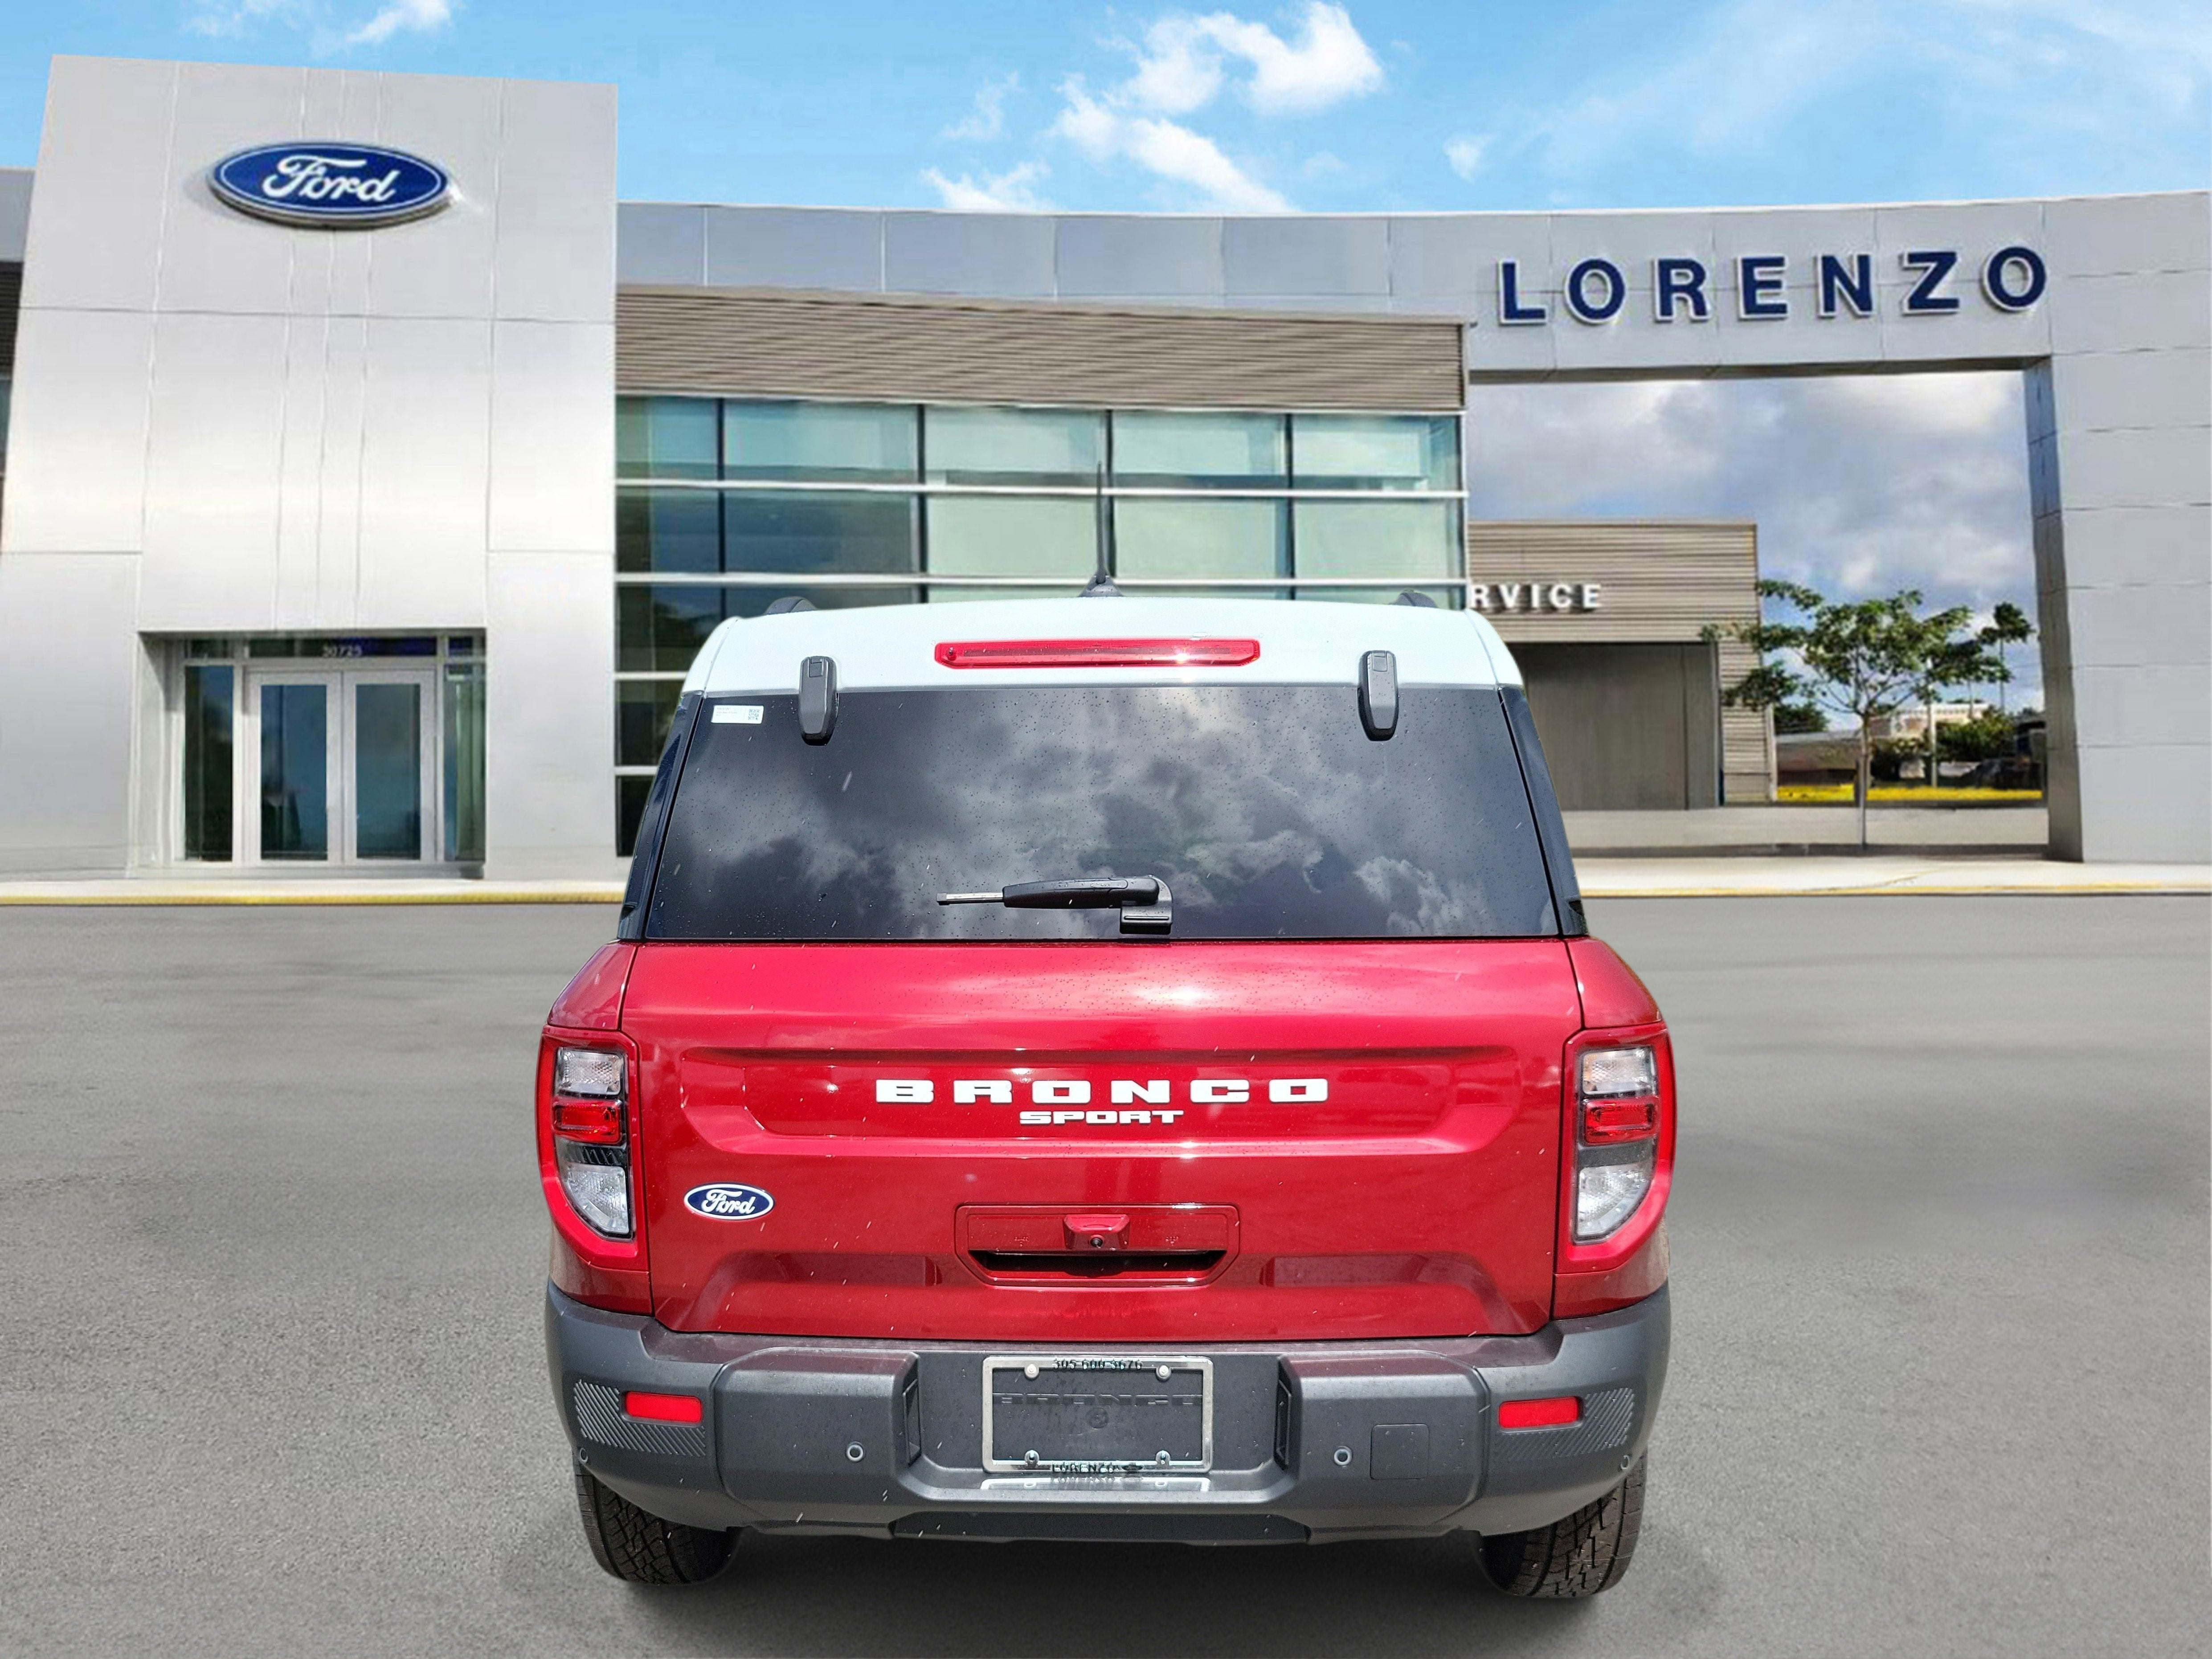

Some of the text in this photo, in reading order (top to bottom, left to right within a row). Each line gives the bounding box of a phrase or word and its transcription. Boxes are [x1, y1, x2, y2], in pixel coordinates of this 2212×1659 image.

[262, 154, 400, 202] Ford
[1498, 245, 2047, 325] LORENZO
[1470, 584, 1602, 609] RVICE
[875, 1078, 1329, 1104] BRONCO
[1019, 1110, 1184, 1125] SPORT
[701, 1189, 756, 1214] Ford
[1052, 1461, 1115, 1474] LORENZO
